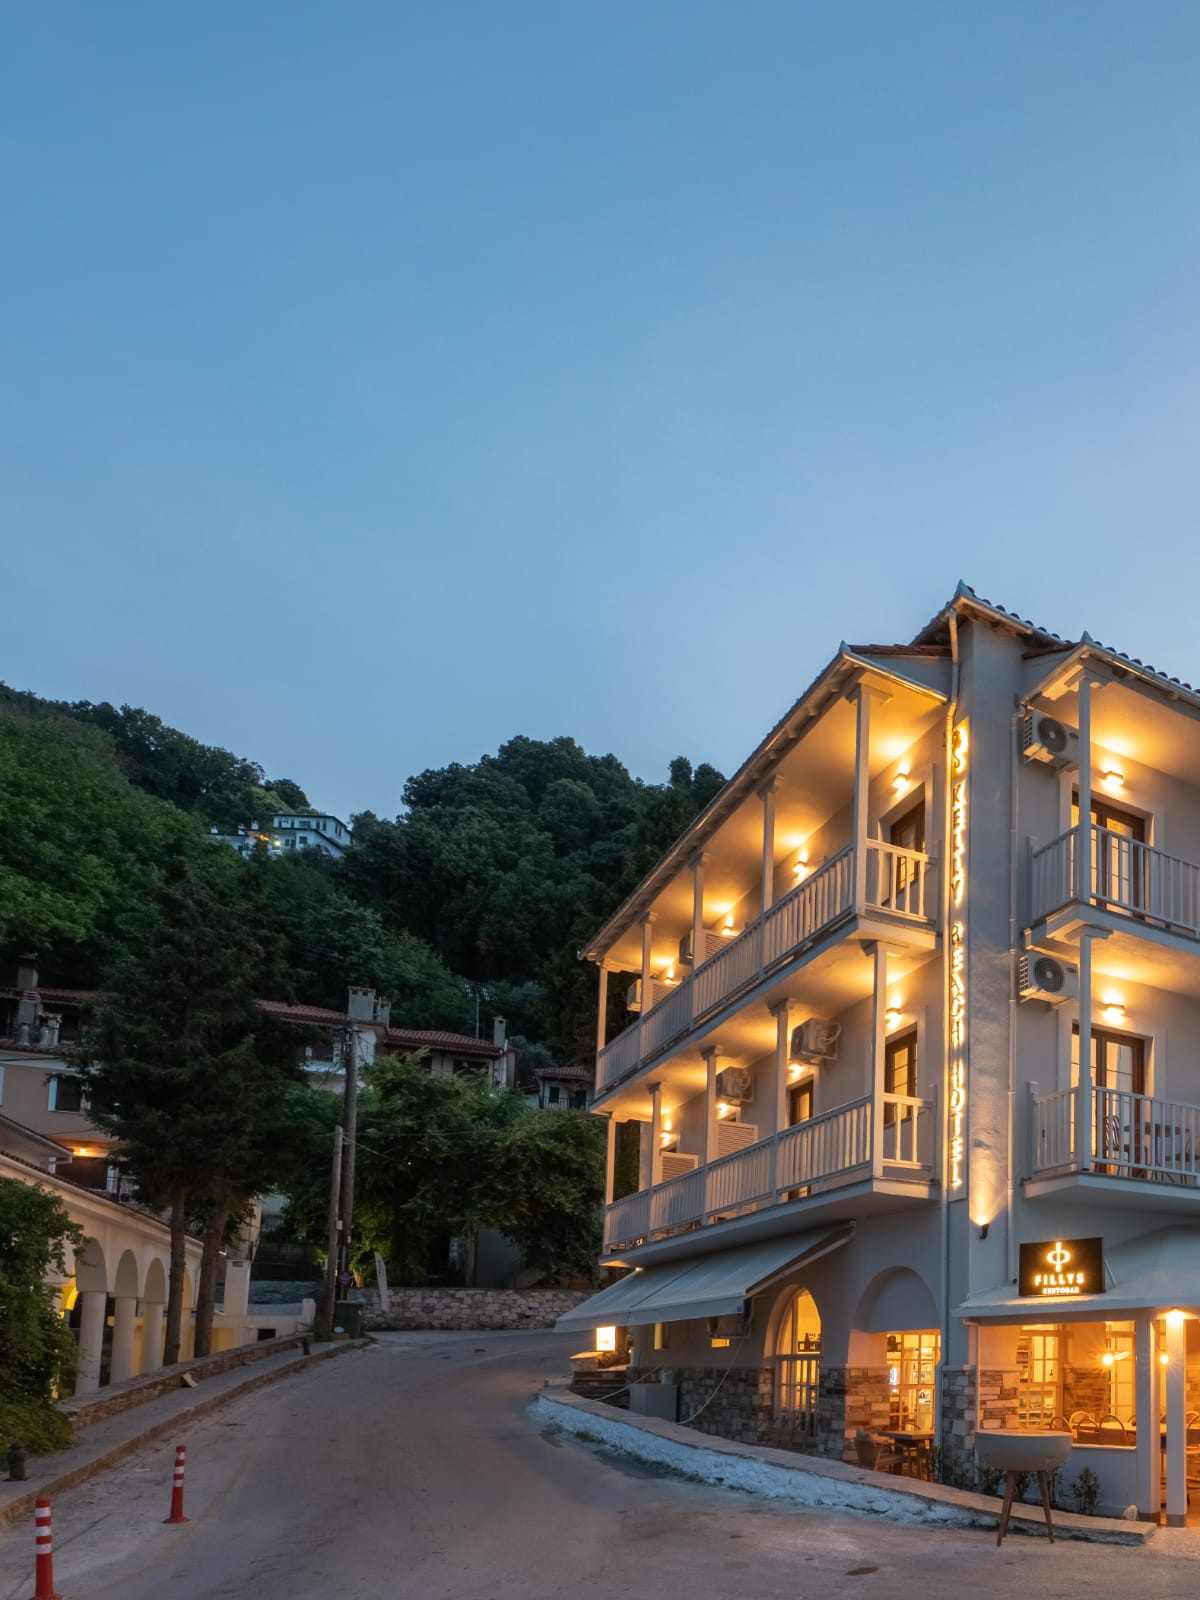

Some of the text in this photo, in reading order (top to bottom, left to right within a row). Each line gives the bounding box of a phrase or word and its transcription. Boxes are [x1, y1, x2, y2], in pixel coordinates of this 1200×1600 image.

[951, 781, 966, 907] KELLY
[951, 1058, 965, 1189] HOTEL
[1035, 1273, 1084, 1286] FILLYS
